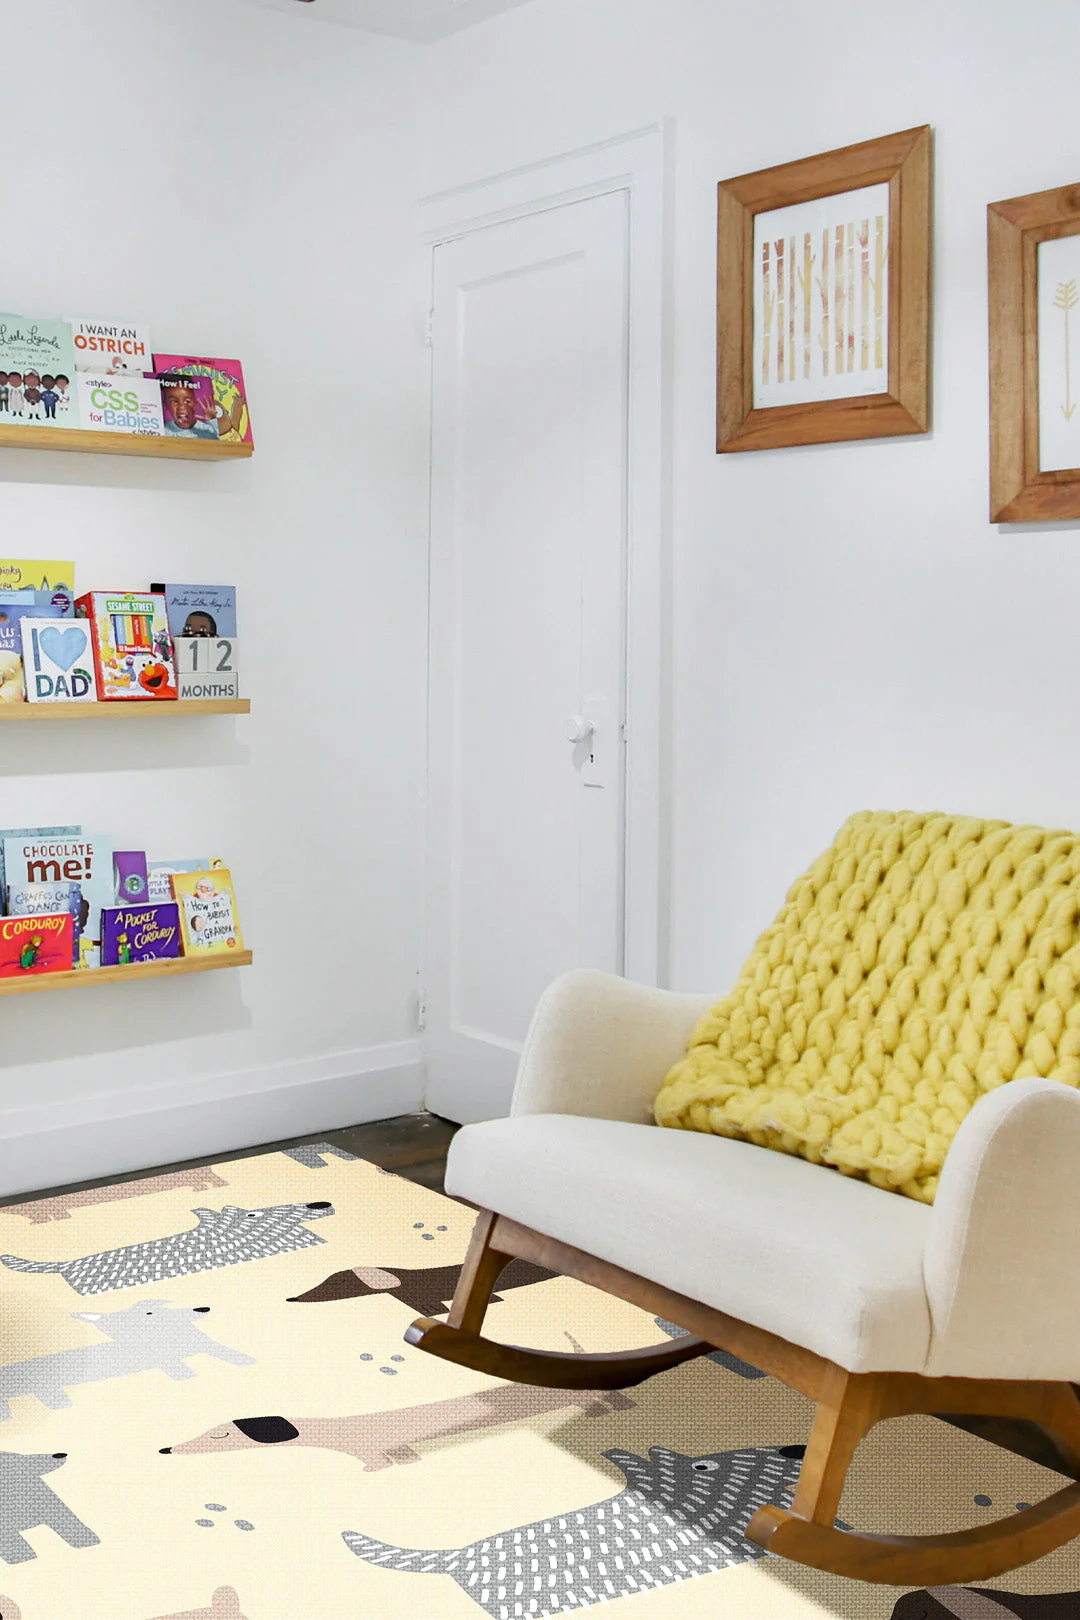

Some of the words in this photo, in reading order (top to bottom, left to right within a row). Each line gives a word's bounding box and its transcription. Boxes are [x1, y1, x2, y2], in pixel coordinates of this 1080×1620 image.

[79, 323, 84, 333] I
[86, 324, 118, 337] WANT
[120, 328, 137, 339] AN
[74, 334, 145, 356] OSTRICH
[183, 380, 201, 390] Feel
[90, 388, 140, 412] CSS
[89, 412, 103, 422] for
[104, 410, 160, 429] Babies
[108, 602, 130, 611] SESAME
[132, 603, 152, 612] STREET
[32, 628, 41, 671] I
[35, 674, 89, 697] DAD
[181, 684, 234, 697] MONTHS
[23, 843, 94, 858] CHOCOLATE
[27, 857, 92, 883] me!
[2, 917, 66, 940] CORDUROY
[114, 911, 124, 925] A
[124, 909, 158, 929] POCKET
[143, 921, 159, 932] FOR
[134, 926, 176, 952] CORDUROY
